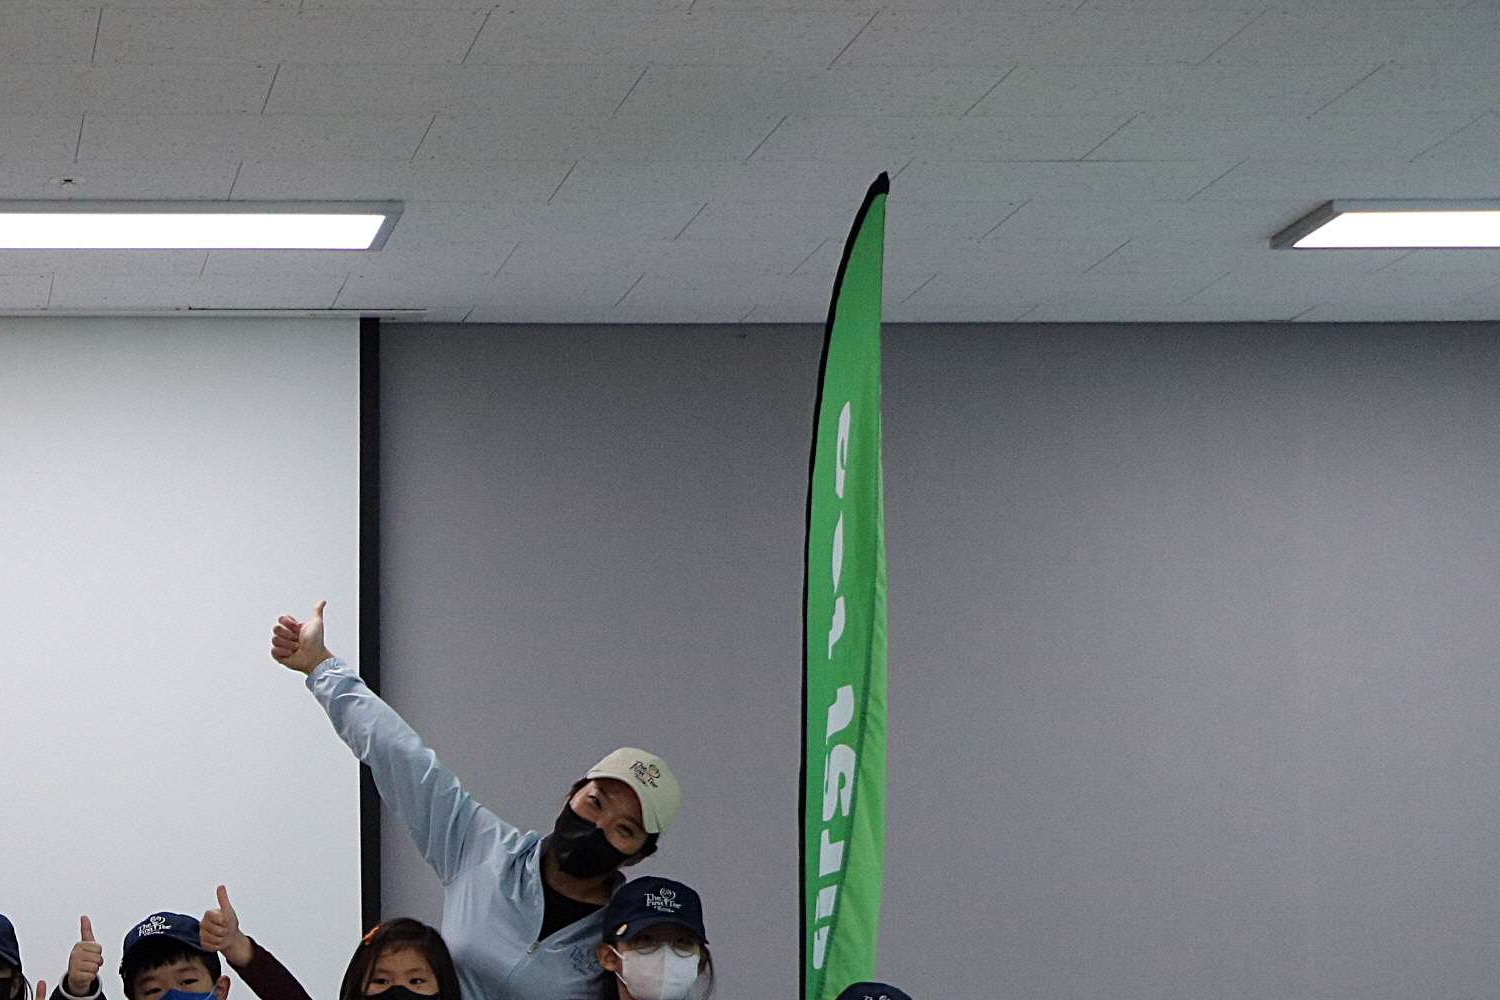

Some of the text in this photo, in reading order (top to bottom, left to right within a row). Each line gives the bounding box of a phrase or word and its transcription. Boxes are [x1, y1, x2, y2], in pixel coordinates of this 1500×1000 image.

[644, 893, 662, 901] The
[646, 899, 681, 909] First Tee
[138, 923, 152, 931] The
[138, 928, 153, 937] First
